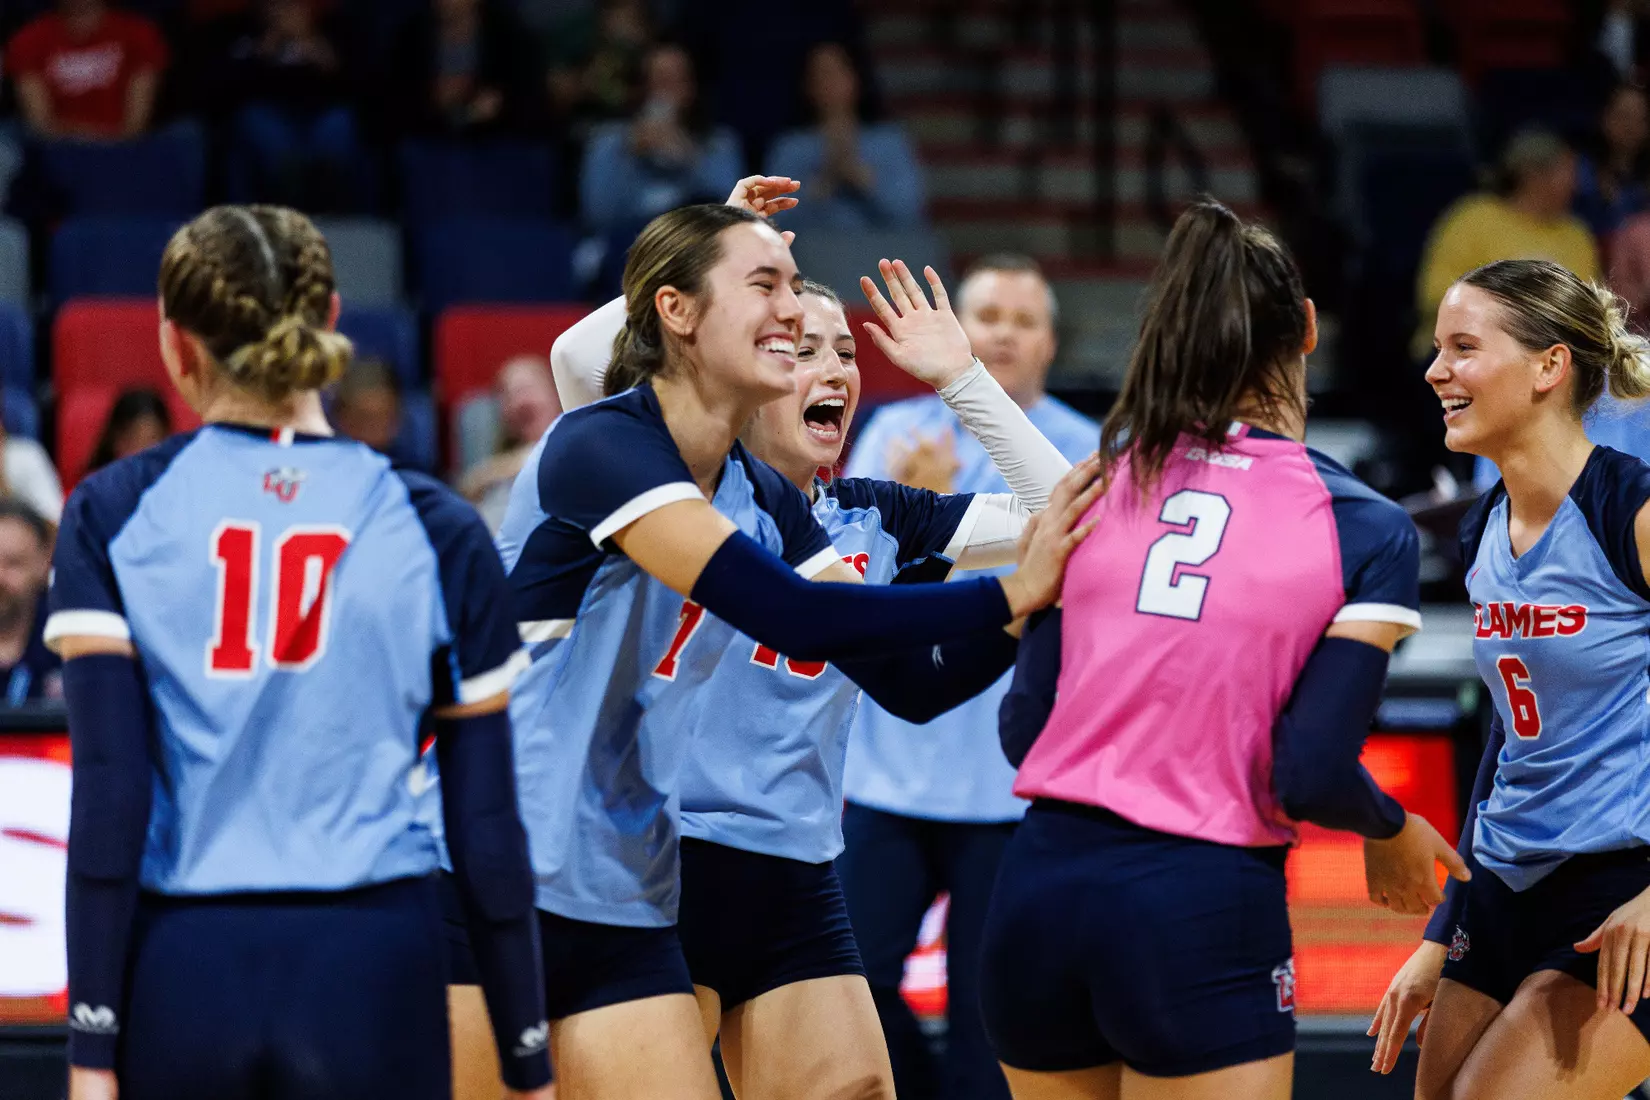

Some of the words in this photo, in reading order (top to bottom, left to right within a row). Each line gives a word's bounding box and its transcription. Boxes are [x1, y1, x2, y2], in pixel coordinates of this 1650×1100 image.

[205, 518, 353, 679] 10
[1135, 488, 1233, 622] 2
[1473, 601, 1589, 640] LAMES
[1496, 654, 1543, 740] 6
